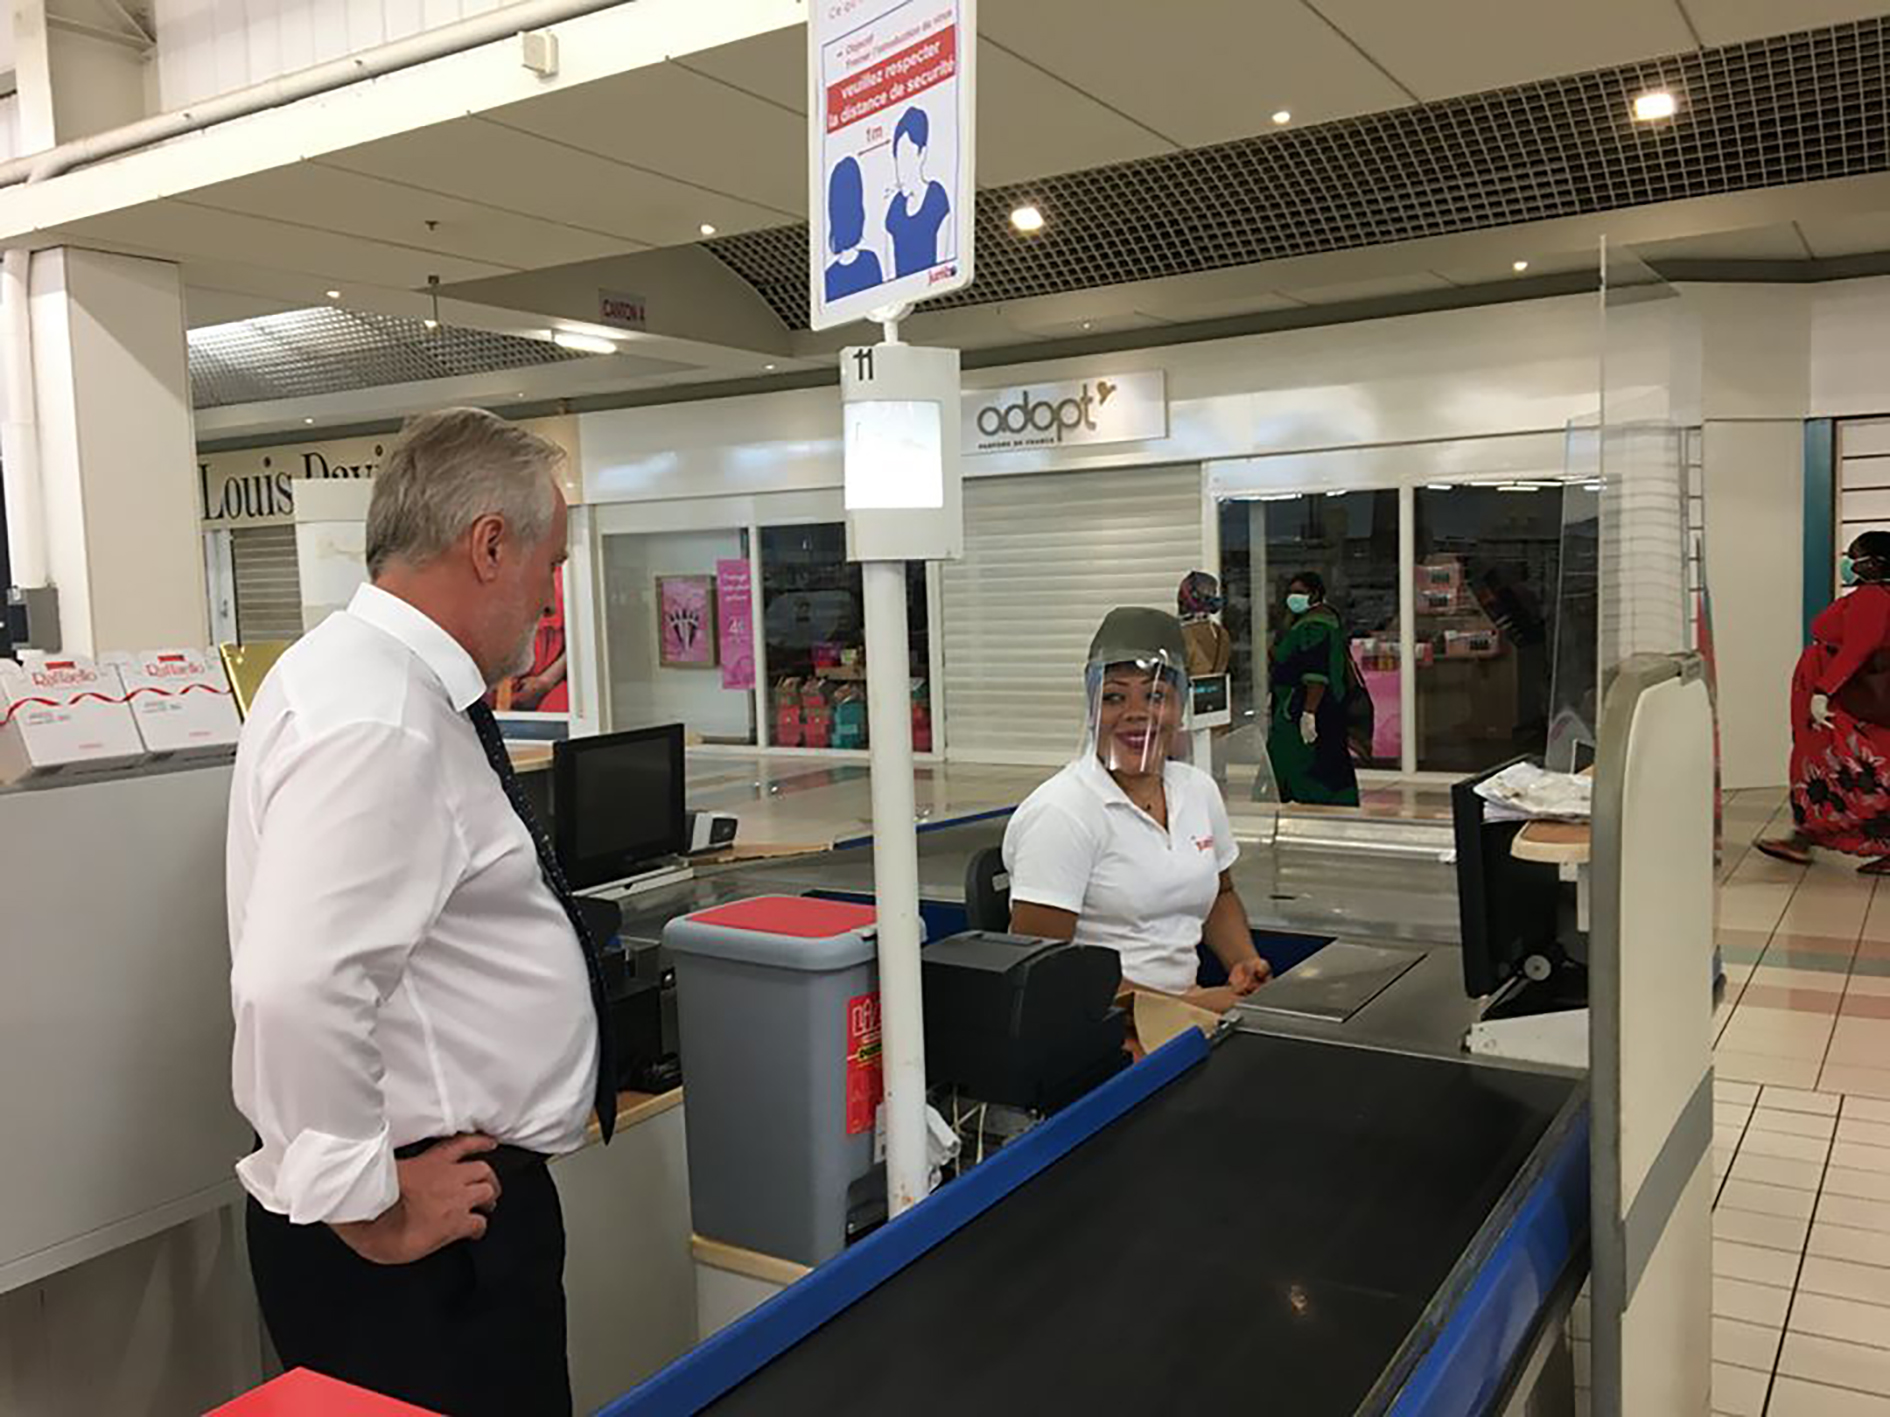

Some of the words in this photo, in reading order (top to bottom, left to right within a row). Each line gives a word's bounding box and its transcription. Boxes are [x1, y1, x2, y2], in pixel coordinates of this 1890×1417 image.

[842, 70, 883, 99] veuillez
[885, 42, 942, 78] respecter
[828, 112, 840, 128] la
[840, 92, 887, 123] distance
[889, 82, 905, 100] de
[866, 125, 883, 142] 1m
[852, 348, 874, 381] 11
[977, 382, 1097, 442] adopt
[198, 456, 295, 521] Louis
